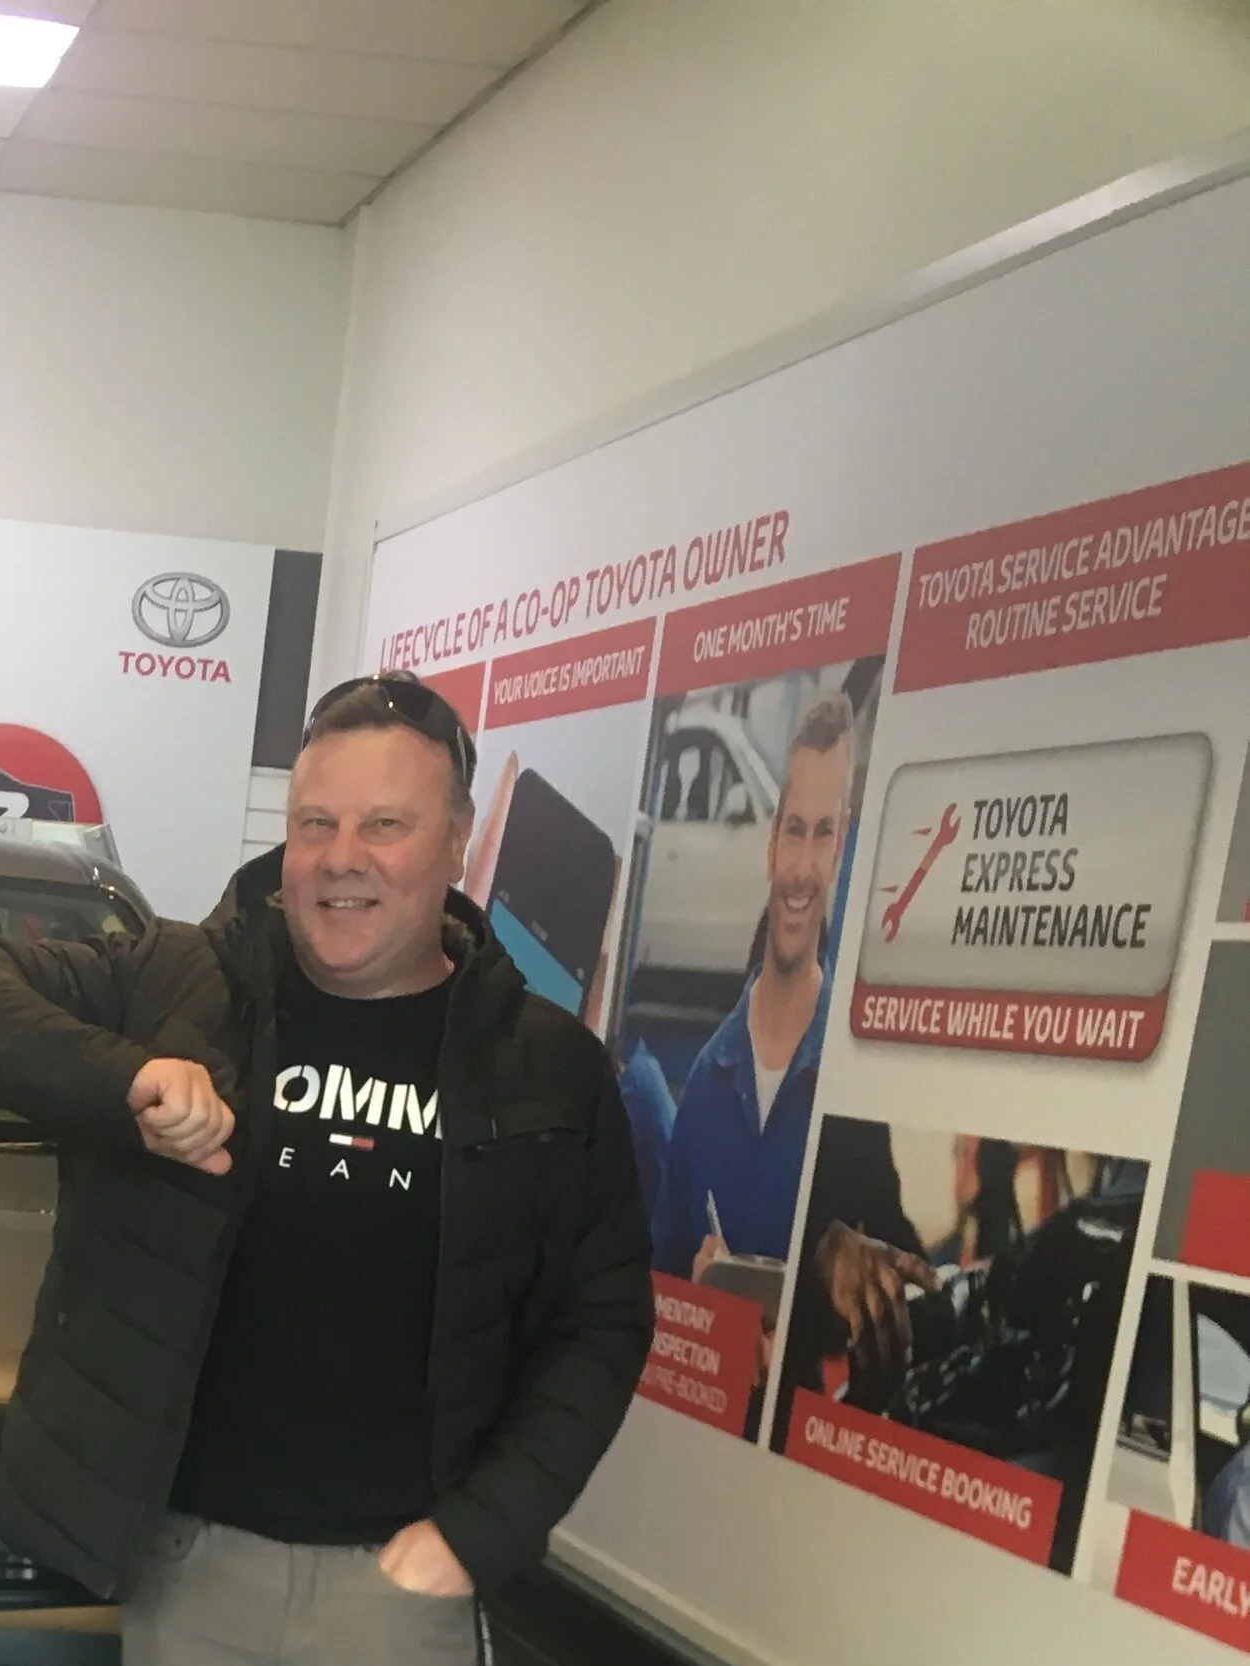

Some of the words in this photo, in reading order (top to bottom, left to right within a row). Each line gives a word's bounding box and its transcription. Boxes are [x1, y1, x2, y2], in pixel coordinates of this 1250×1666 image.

[468, 603, 494, 651] OF
[493, 598, 508, 644] A
[512, 576, 581, 639] CO-OP
[586, 545, 676, 618] TOYOTA
[683, 509, 790, 592] OWNER
[918, 558, 995, 609] TOYOTA
[998, 535, 1094, 594] SERVICE
[1093, 497, 1250, 571] ADVANTAGE
[693, 626, 729, 664] ONE
[726, 608, 804, 653] MONTH'S
[807, 597, 850, 637] TIME
[964, 594, 1062, 650] ROUTINE
[1061, 574, 1168, 633] SERVICE
[117, 649, 233, 684] TOYOTA
[493, 675, 524, 705] YOUR
[523, 666, 560, 698] VOICE
[558, 663, 573, 692] IS
[571, 645, 645, 688] IMPORTANT
[972, 793, 1070, 840] TOYOTA
[961, 847, 1079, 893] EXPRESS
[951, 903, 1152, 949] MAINTENANCE
[861, 994, 945, 1034] SERVICE
[946, 999, 1019, 1040] WHILE
[1022, 1004, 1073, 1044] YOU
[1075, 1007, 1145, 1050] WAIT
[805, 1415, 866, 1462] ONLINE
[865, 1438, 942, 1493] SERVICE
[940, 1467, 1033, 1530] BOOKING
